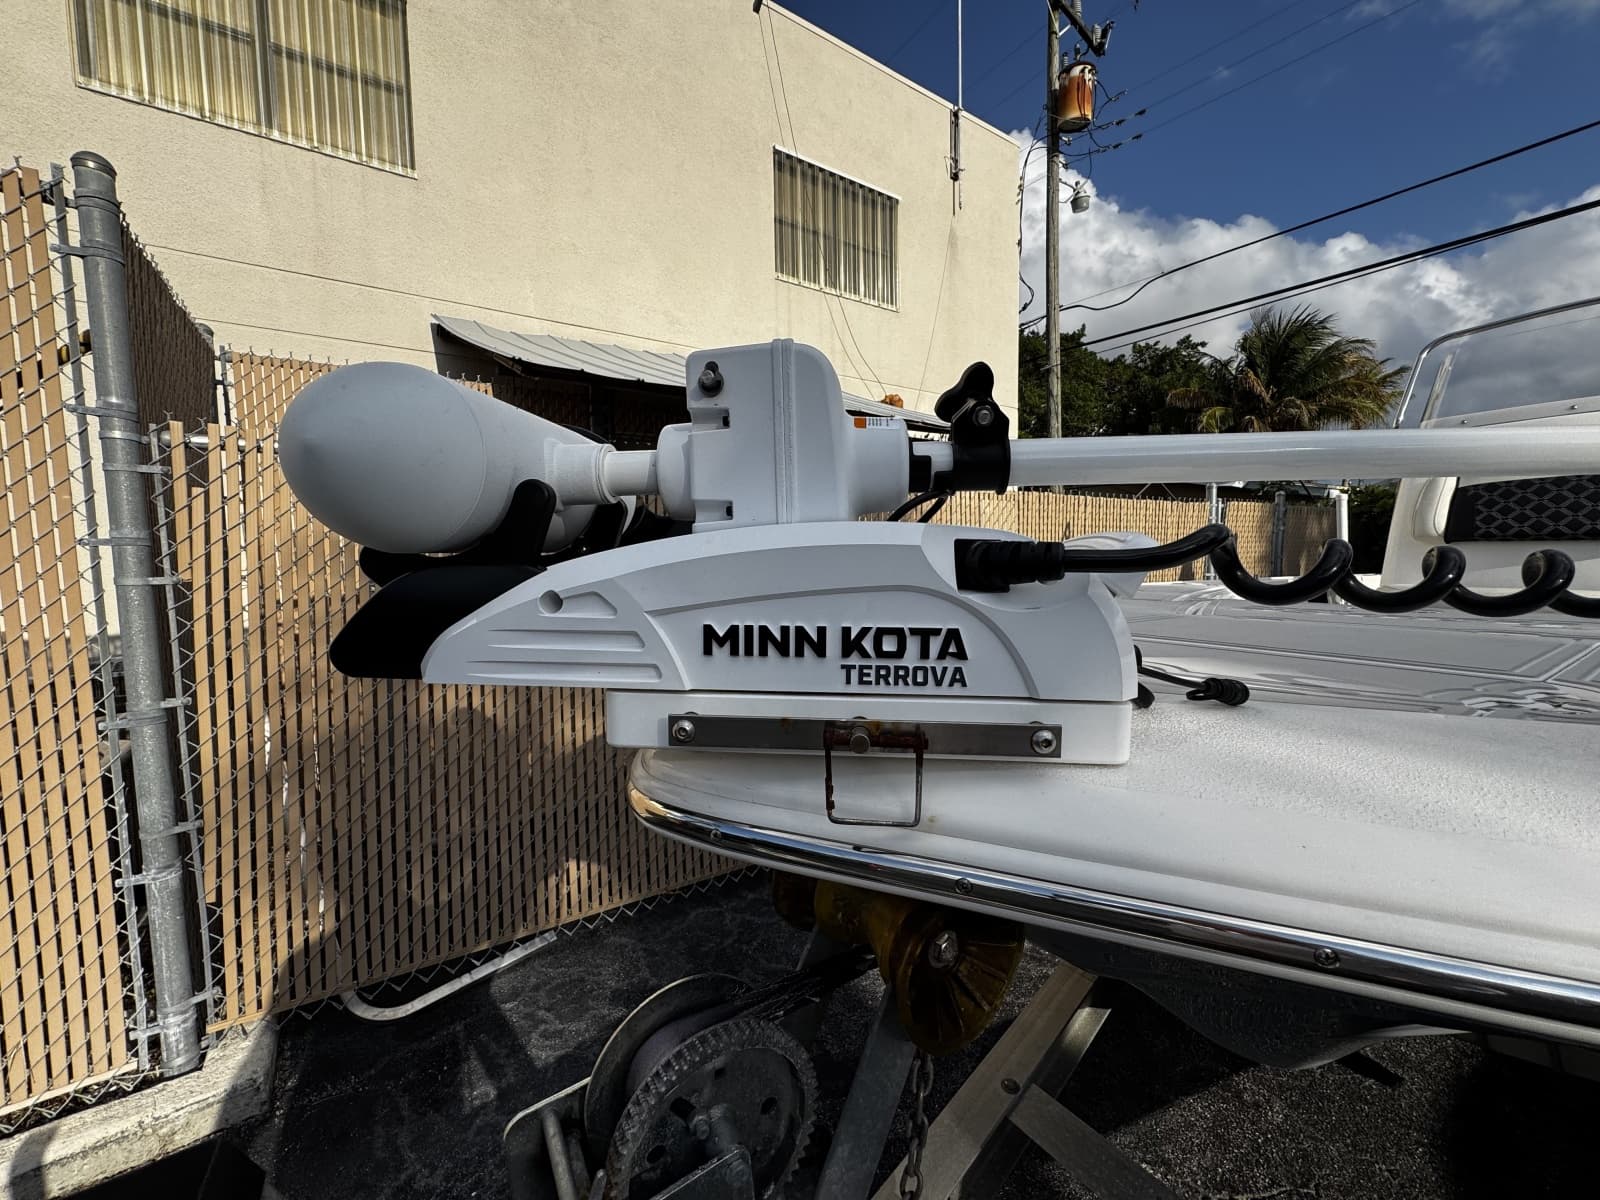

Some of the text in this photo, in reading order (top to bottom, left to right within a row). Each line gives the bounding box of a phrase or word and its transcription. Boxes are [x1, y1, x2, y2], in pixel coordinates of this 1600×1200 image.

[703, 624, 969, 661] MINN KOTA
[840, 664, 968, 688] TERROVA
